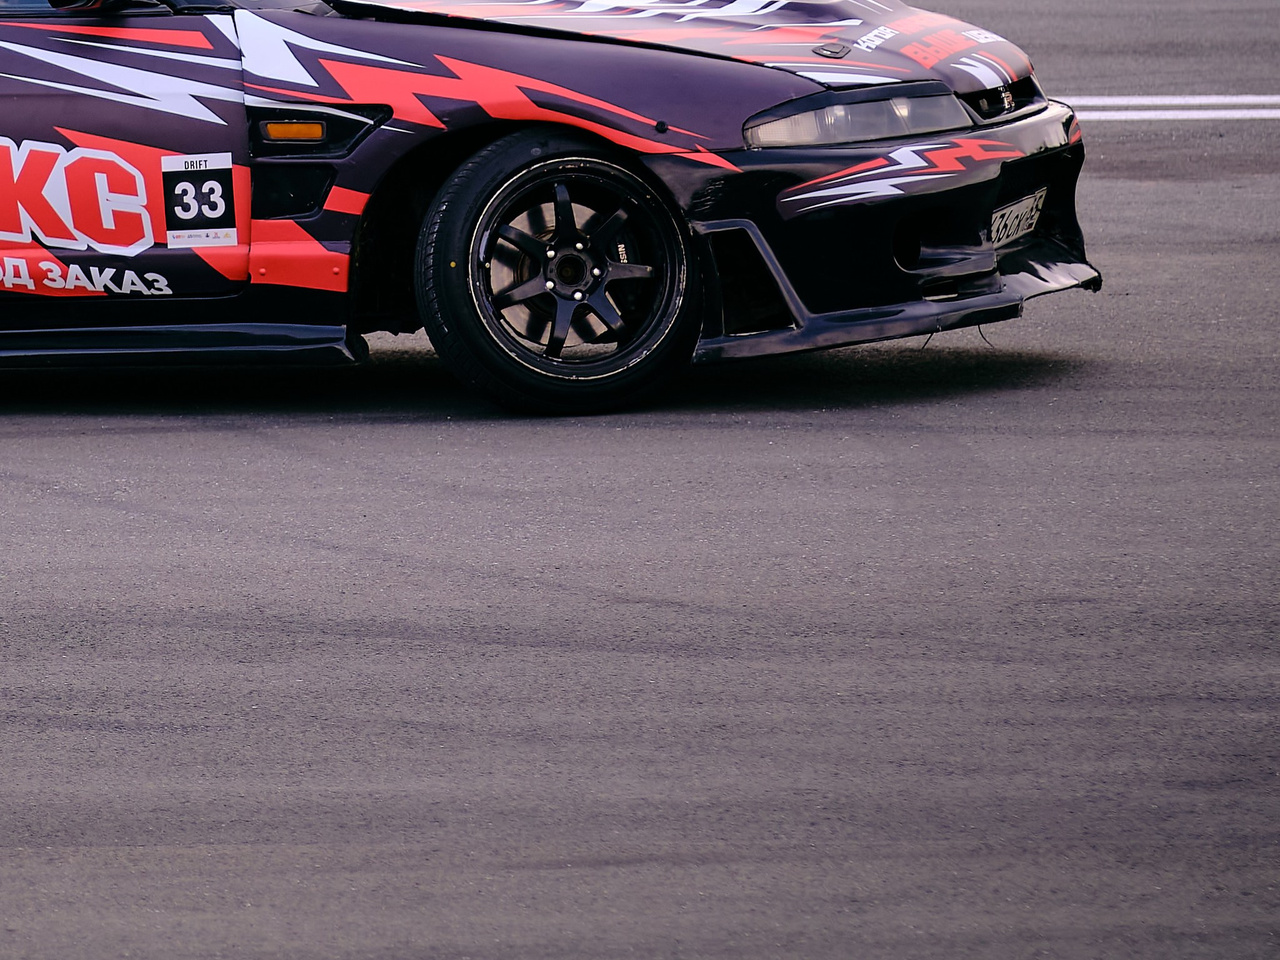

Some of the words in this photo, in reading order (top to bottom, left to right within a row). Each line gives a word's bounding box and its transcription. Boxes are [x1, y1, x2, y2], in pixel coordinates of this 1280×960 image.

[184, 160, 208, 170] DRIFT
[174, 180, 226, 220] 33
[42, 261, 174, 296] ЗАКАЗ
